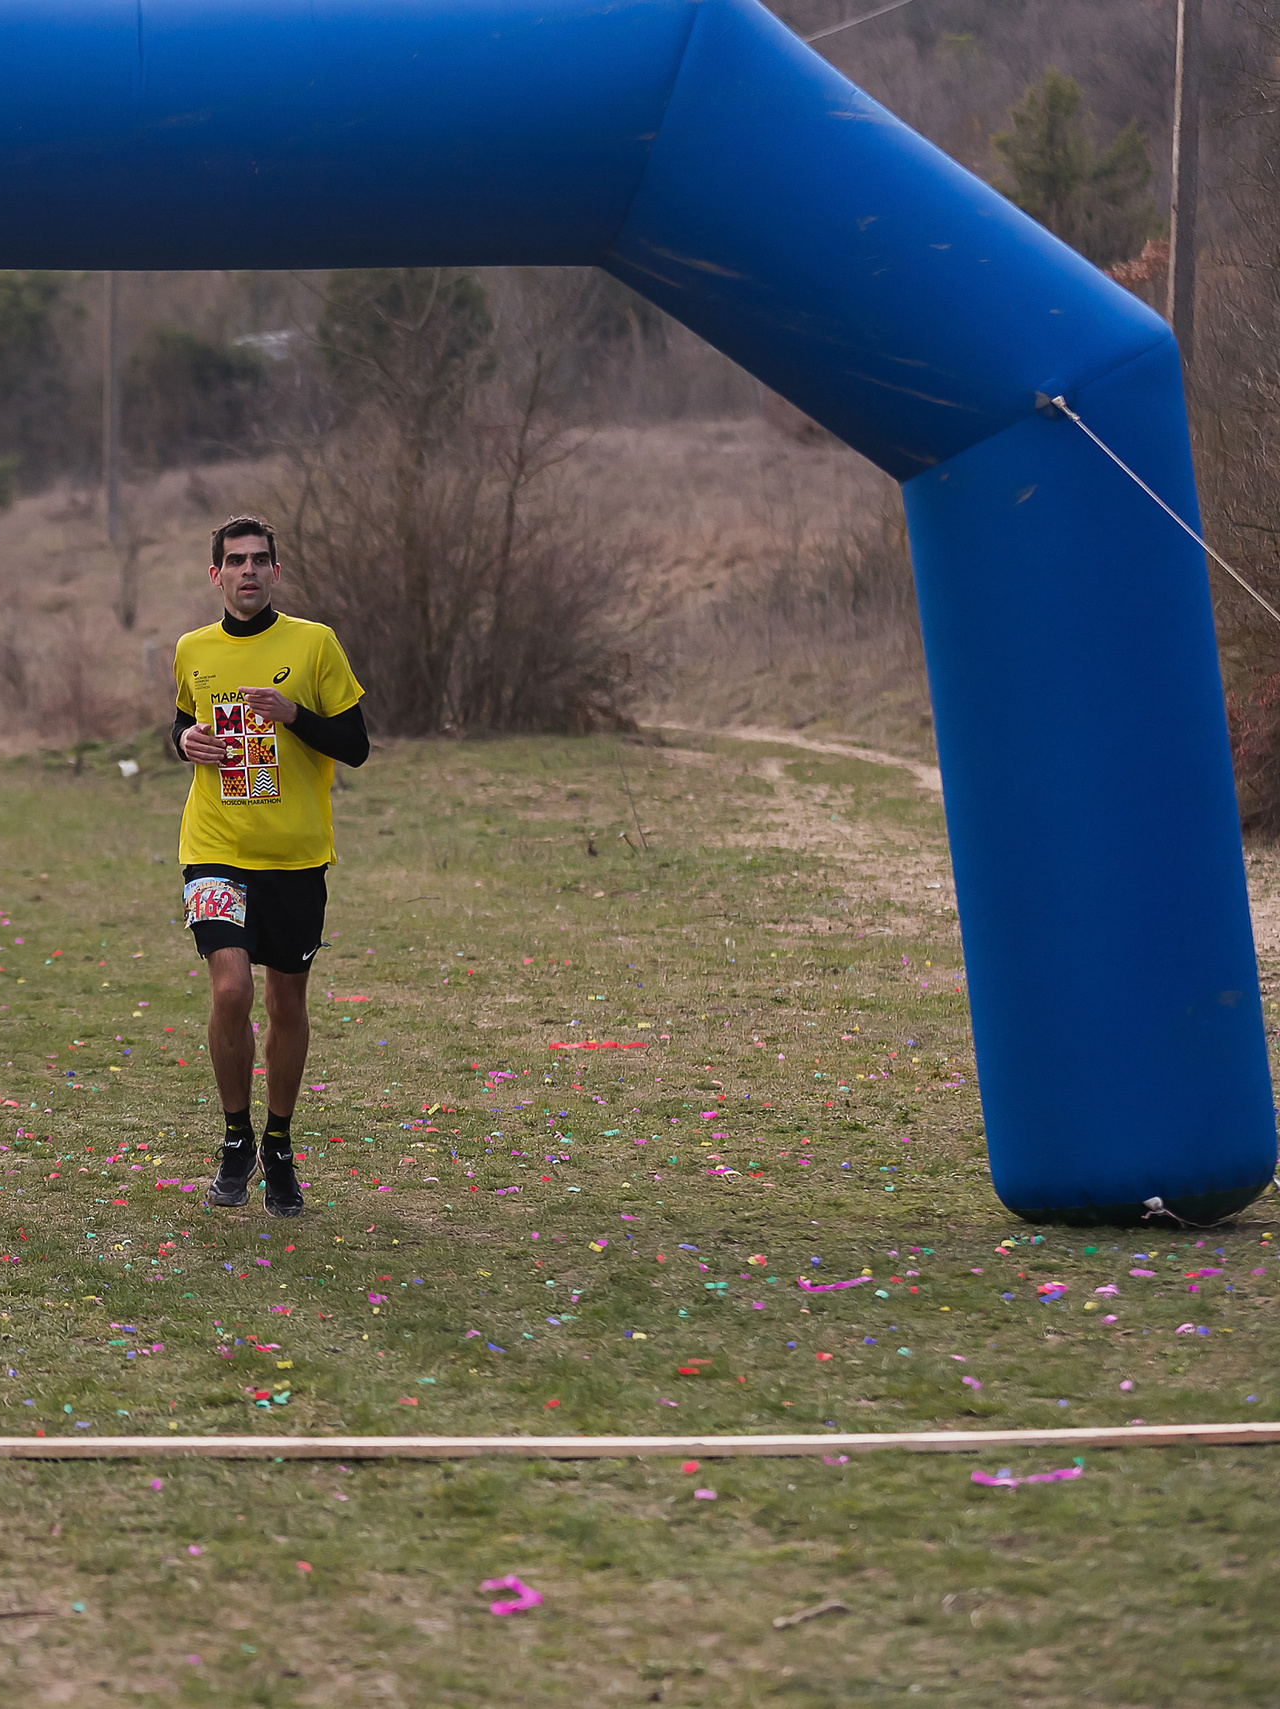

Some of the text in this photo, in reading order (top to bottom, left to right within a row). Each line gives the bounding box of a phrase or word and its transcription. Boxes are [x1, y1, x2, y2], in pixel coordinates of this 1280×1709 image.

[210, 692, 247, 703] МАРА
[248, 797, 282, 806] MARATHON
[193, 890, 231, 919] 162
